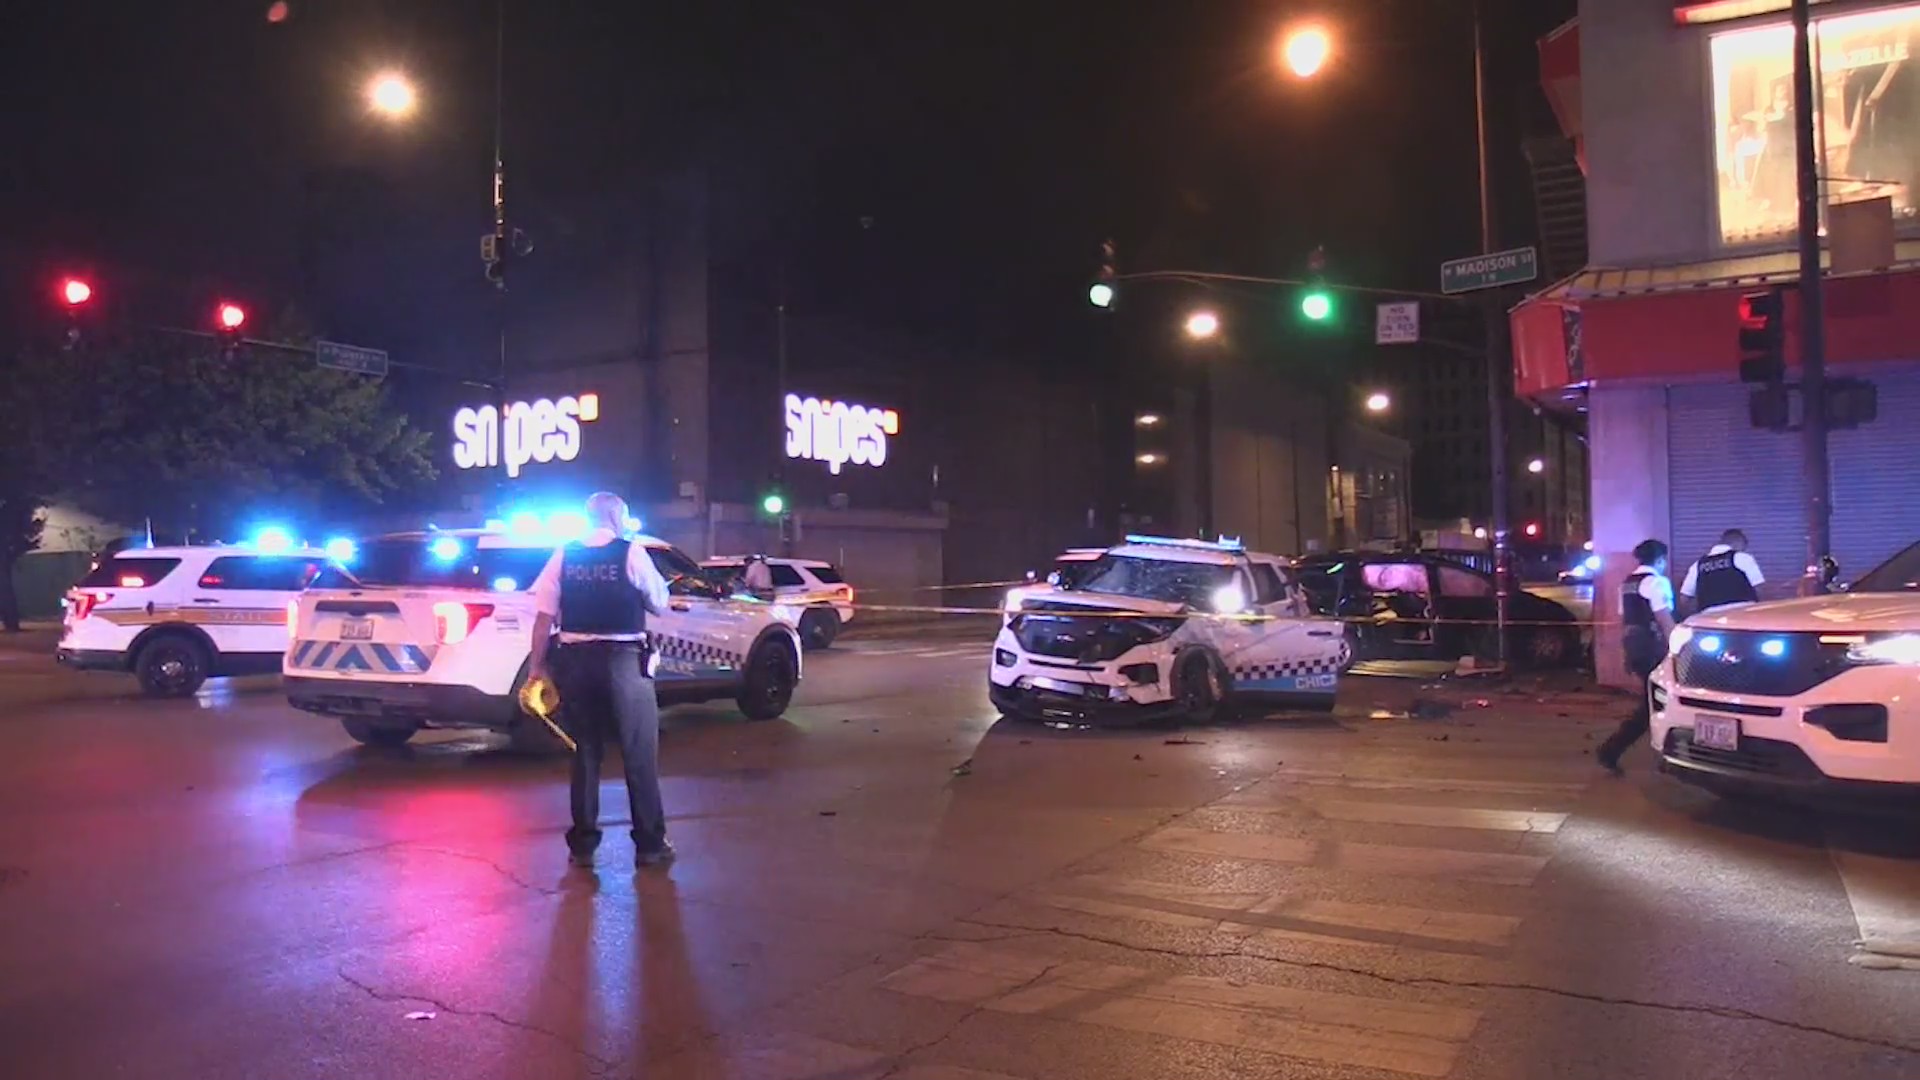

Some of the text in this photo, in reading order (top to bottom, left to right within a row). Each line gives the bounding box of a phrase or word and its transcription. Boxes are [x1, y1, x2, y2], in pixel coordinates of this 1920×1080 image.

[1455, 255, 1516, 276] MADISON
[1389, 306, 1405, 314] NO
[1386, 315, 1410, 324] TURN
[453, 395, 582, 478] snipes
[784, 394, 887, 476] snipes
[566, 563, 619, 581] POLICE
[1699, 559, 1732, 574] POLICE
